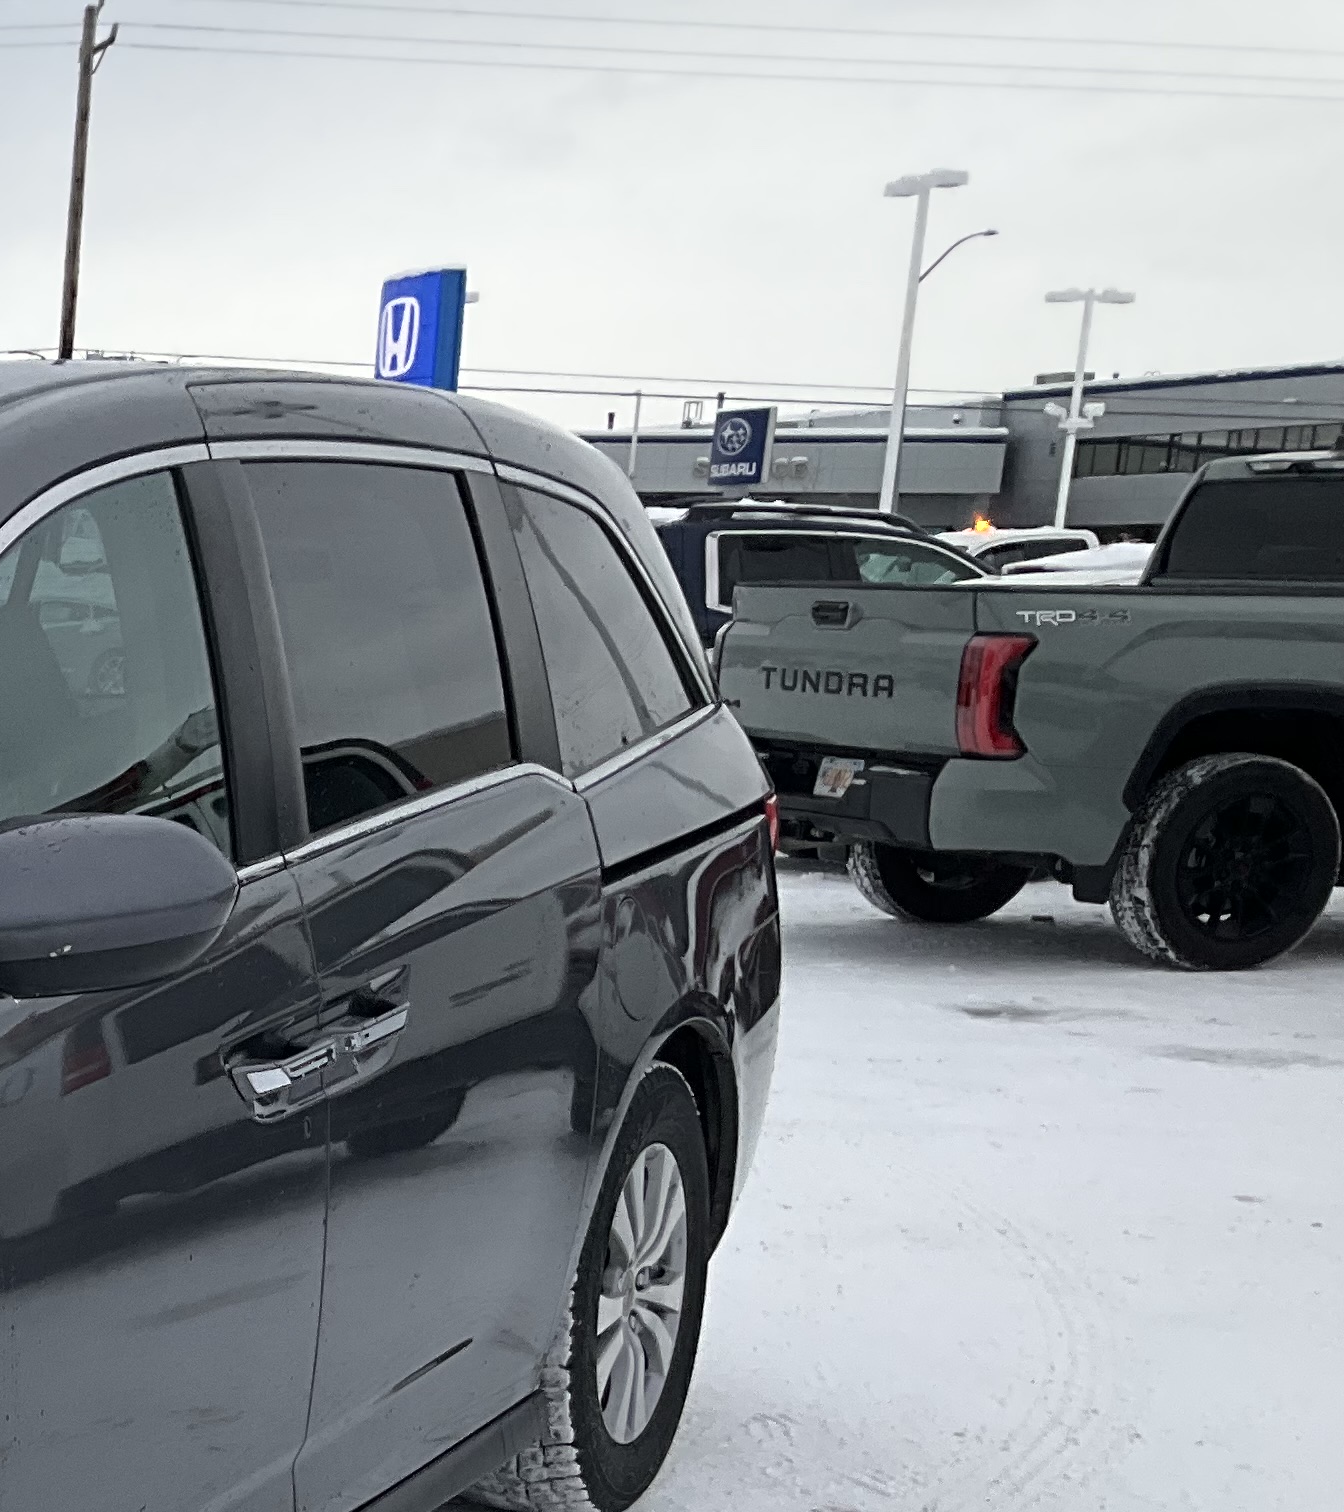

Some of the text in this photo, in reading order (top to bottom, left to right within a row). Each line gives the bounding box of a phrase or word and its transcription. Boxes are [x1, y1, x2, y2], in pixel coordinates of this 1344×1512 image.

[711, 462, 756, 478] SUBARU
[1015, 610, 1076, 627] TRD
[761, 666, 894, 699] TUNDRA
